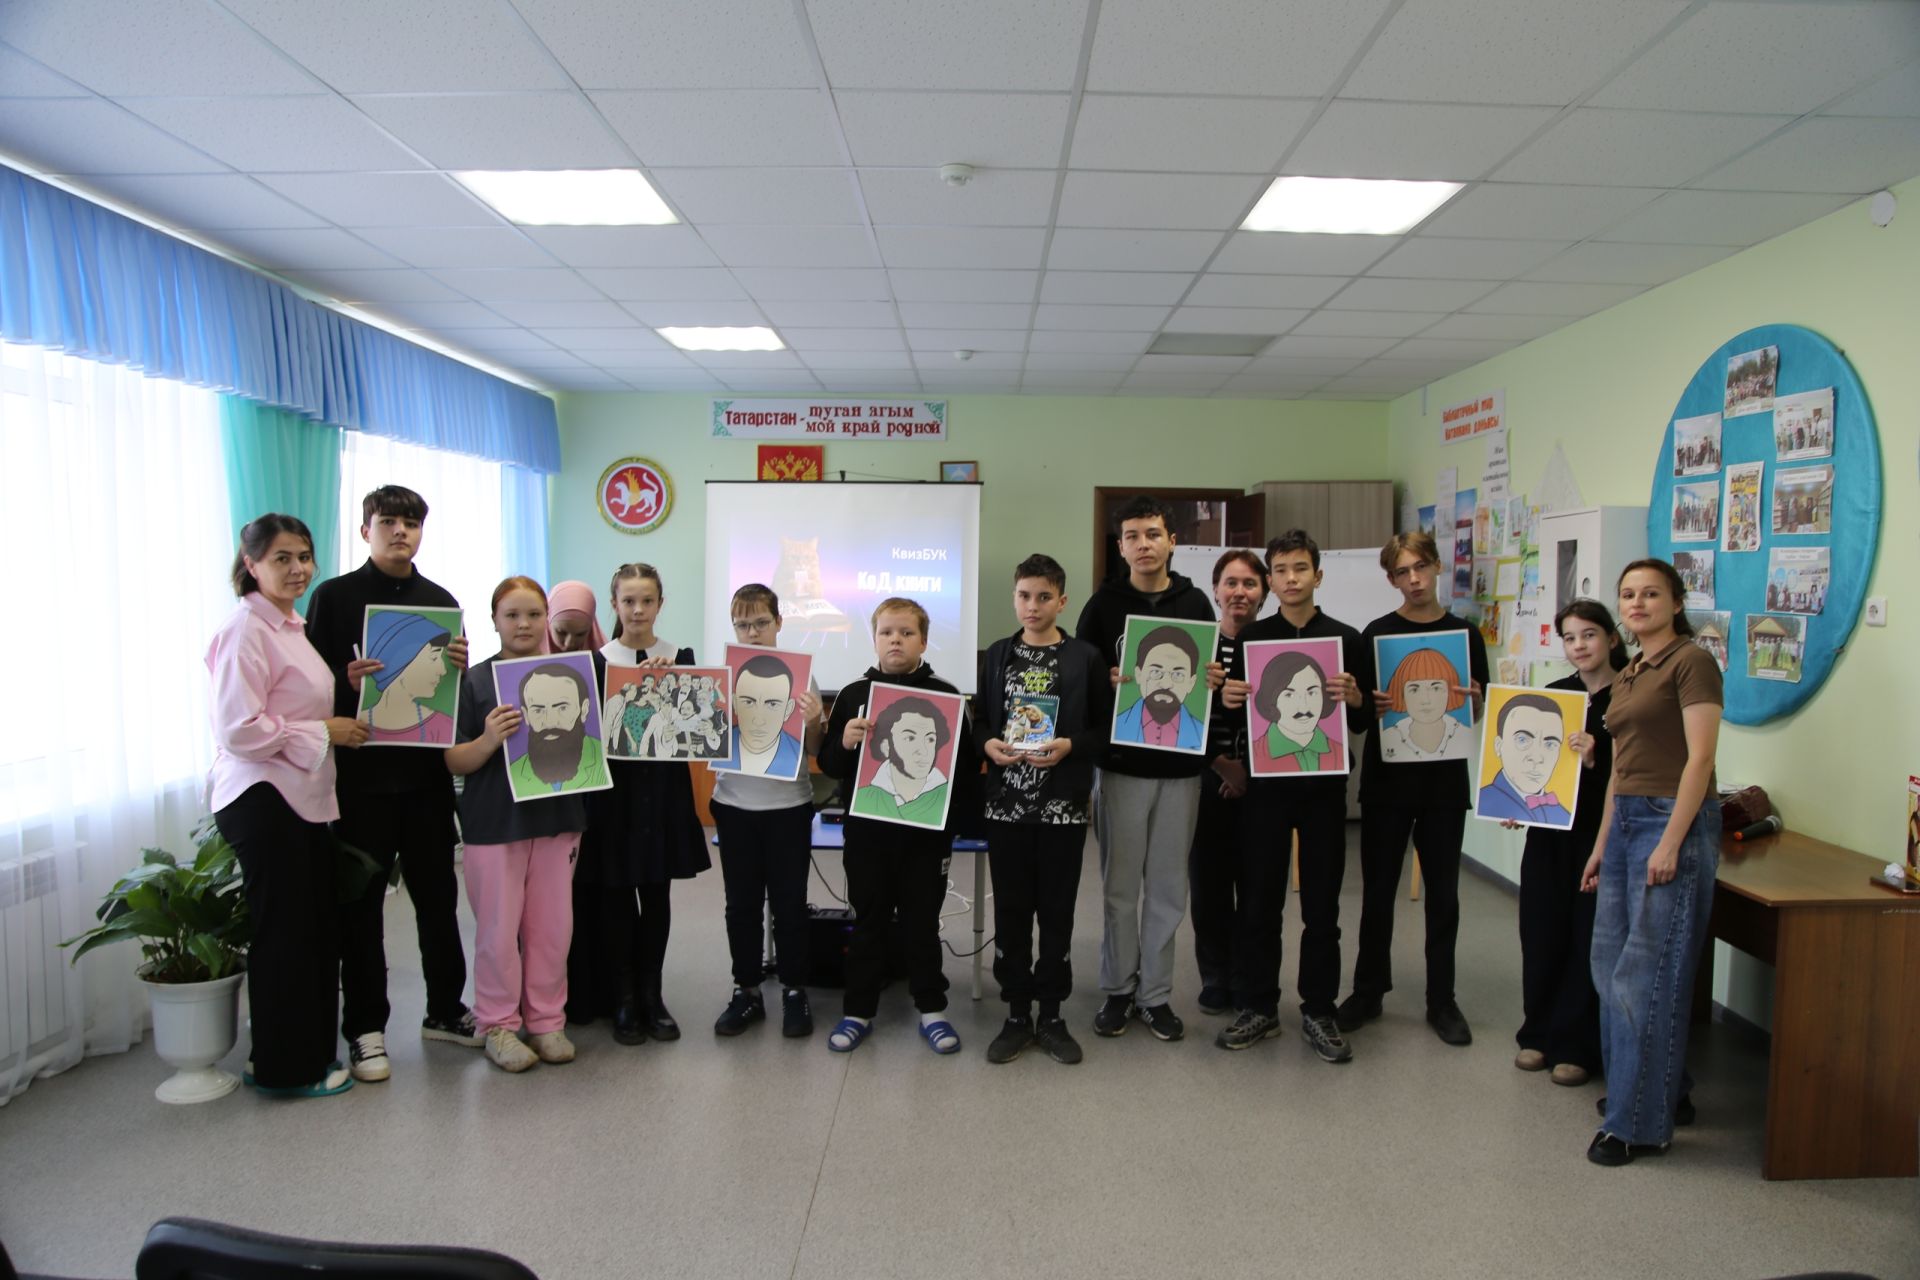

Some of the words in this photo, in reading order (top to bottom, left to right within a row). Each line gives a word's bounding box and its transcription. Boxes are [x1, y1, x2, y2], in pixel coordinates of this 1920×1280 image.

[725, 410, 797, 427] Татарстан
[809, 406, 862, 421] туган
[869, 406, 914, 418] ягым
[805, 420, 835, 433] мой
[842, 420, 880, 437] край
[887, 421, 941, 437] родной
[891, 547, 947, 560] КвизБУК
[896, 575, 942, 592] книги
